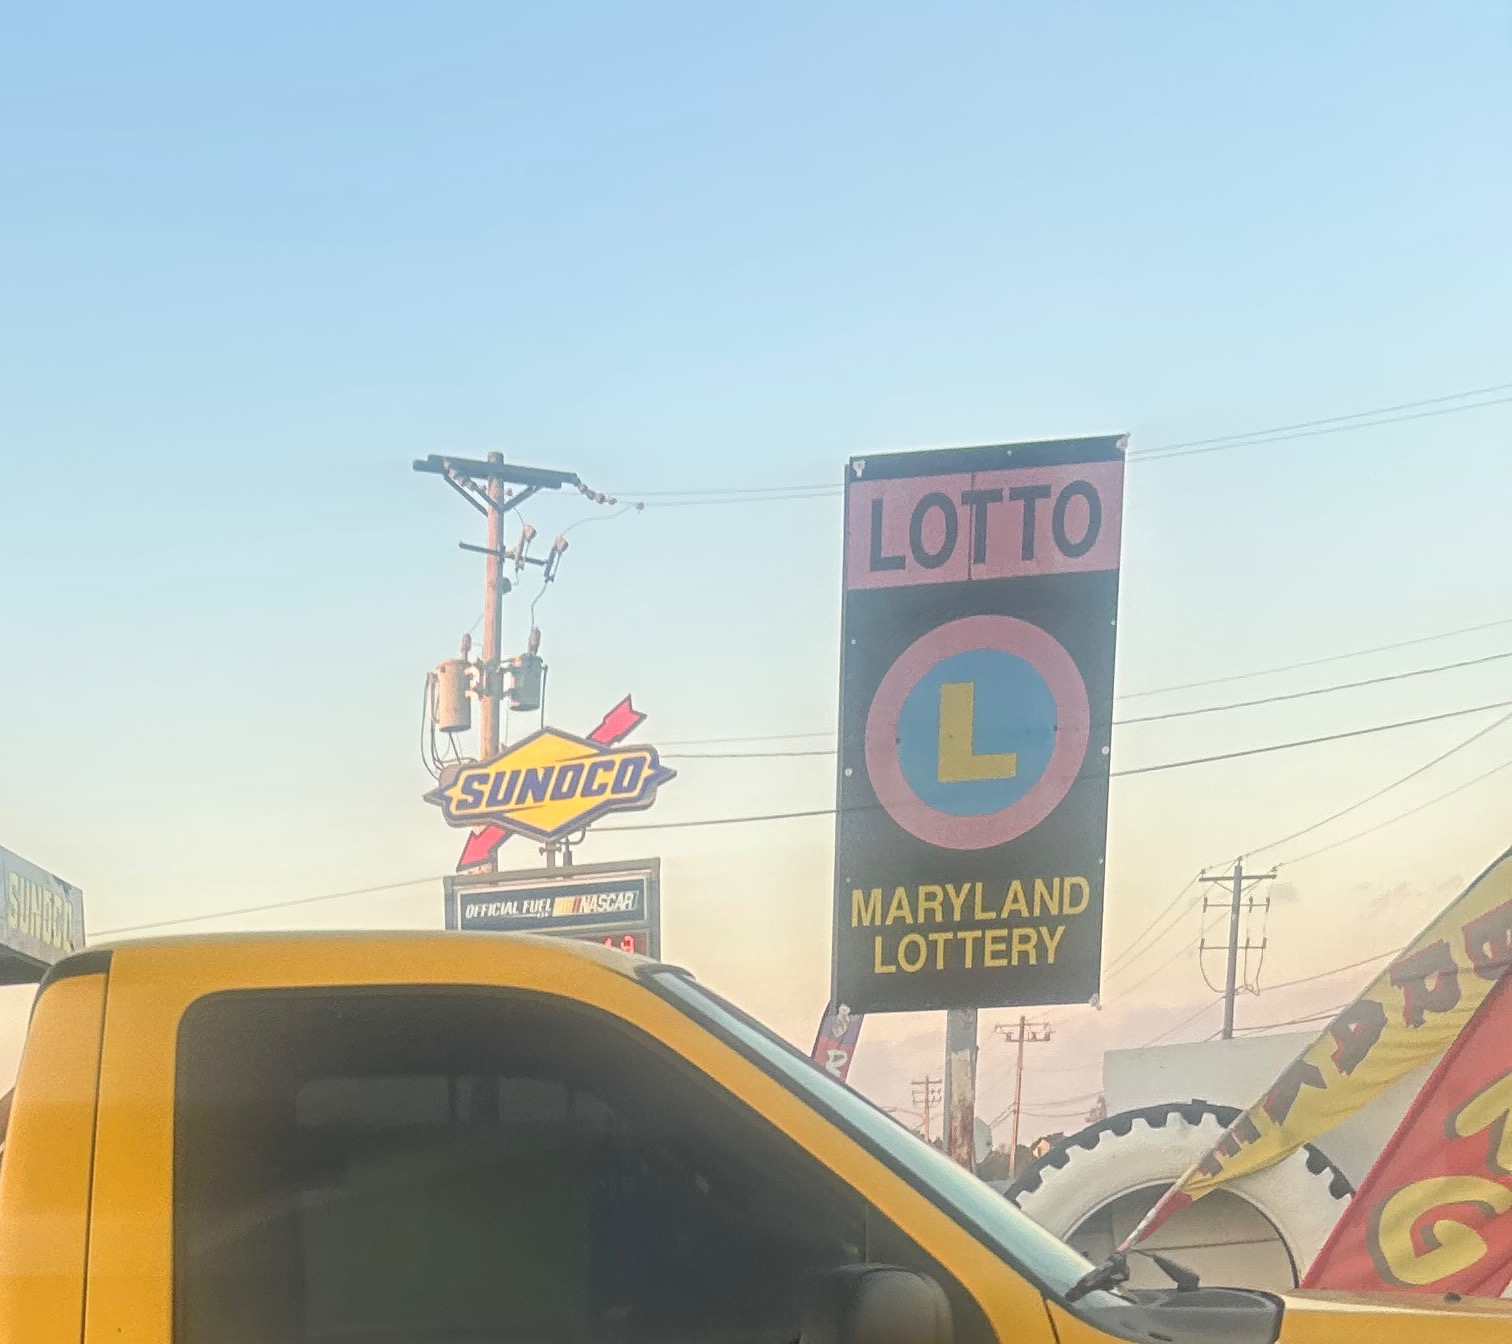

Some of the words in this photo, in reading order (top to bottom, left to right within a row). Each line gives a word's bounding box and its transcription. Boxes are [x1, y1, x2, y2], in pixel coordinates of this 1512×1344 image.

[868, 479, 1102, 571] LOTTO
[937, 682, 1017, 782] L
[455, 756, 647, 811] SUNOCO
[465, 900, 519, 919] OFFICIAL
[522, 897, 553, 915] FUEL
[577, 892, 635, 914] NASCAR
[851, 876, 1090, 928] MARYLAND
[874, 925, 1066, 974] LOTTERY
